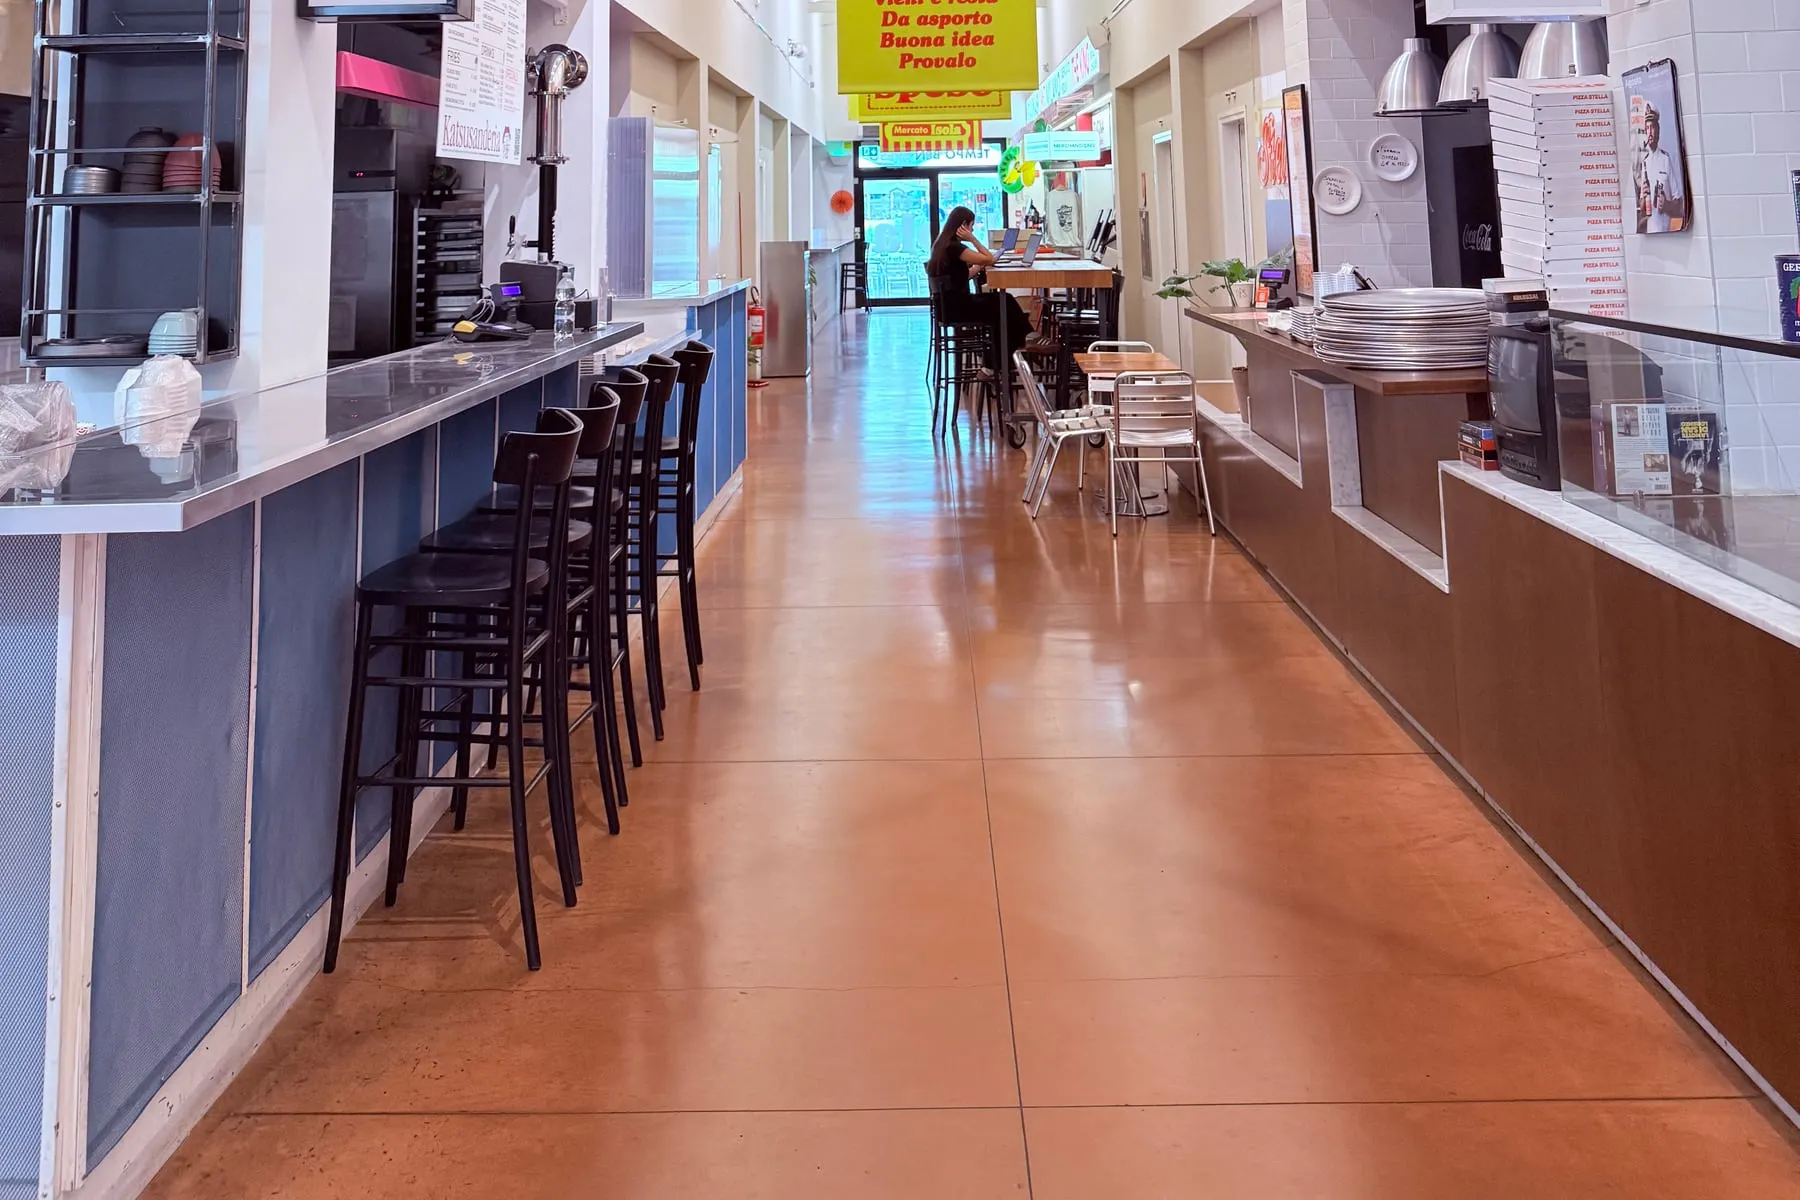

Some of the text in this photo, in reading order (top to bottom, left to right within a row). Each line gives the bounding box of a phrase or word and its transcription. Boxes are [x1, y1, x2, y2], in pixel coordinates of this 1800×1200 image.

[881, 11, 993, 30] Da asporto
[879, 32, 995, 48] Buona idea
[898, 52, 977, 69] Provalo
[932, 124, 961, 134] Isola
